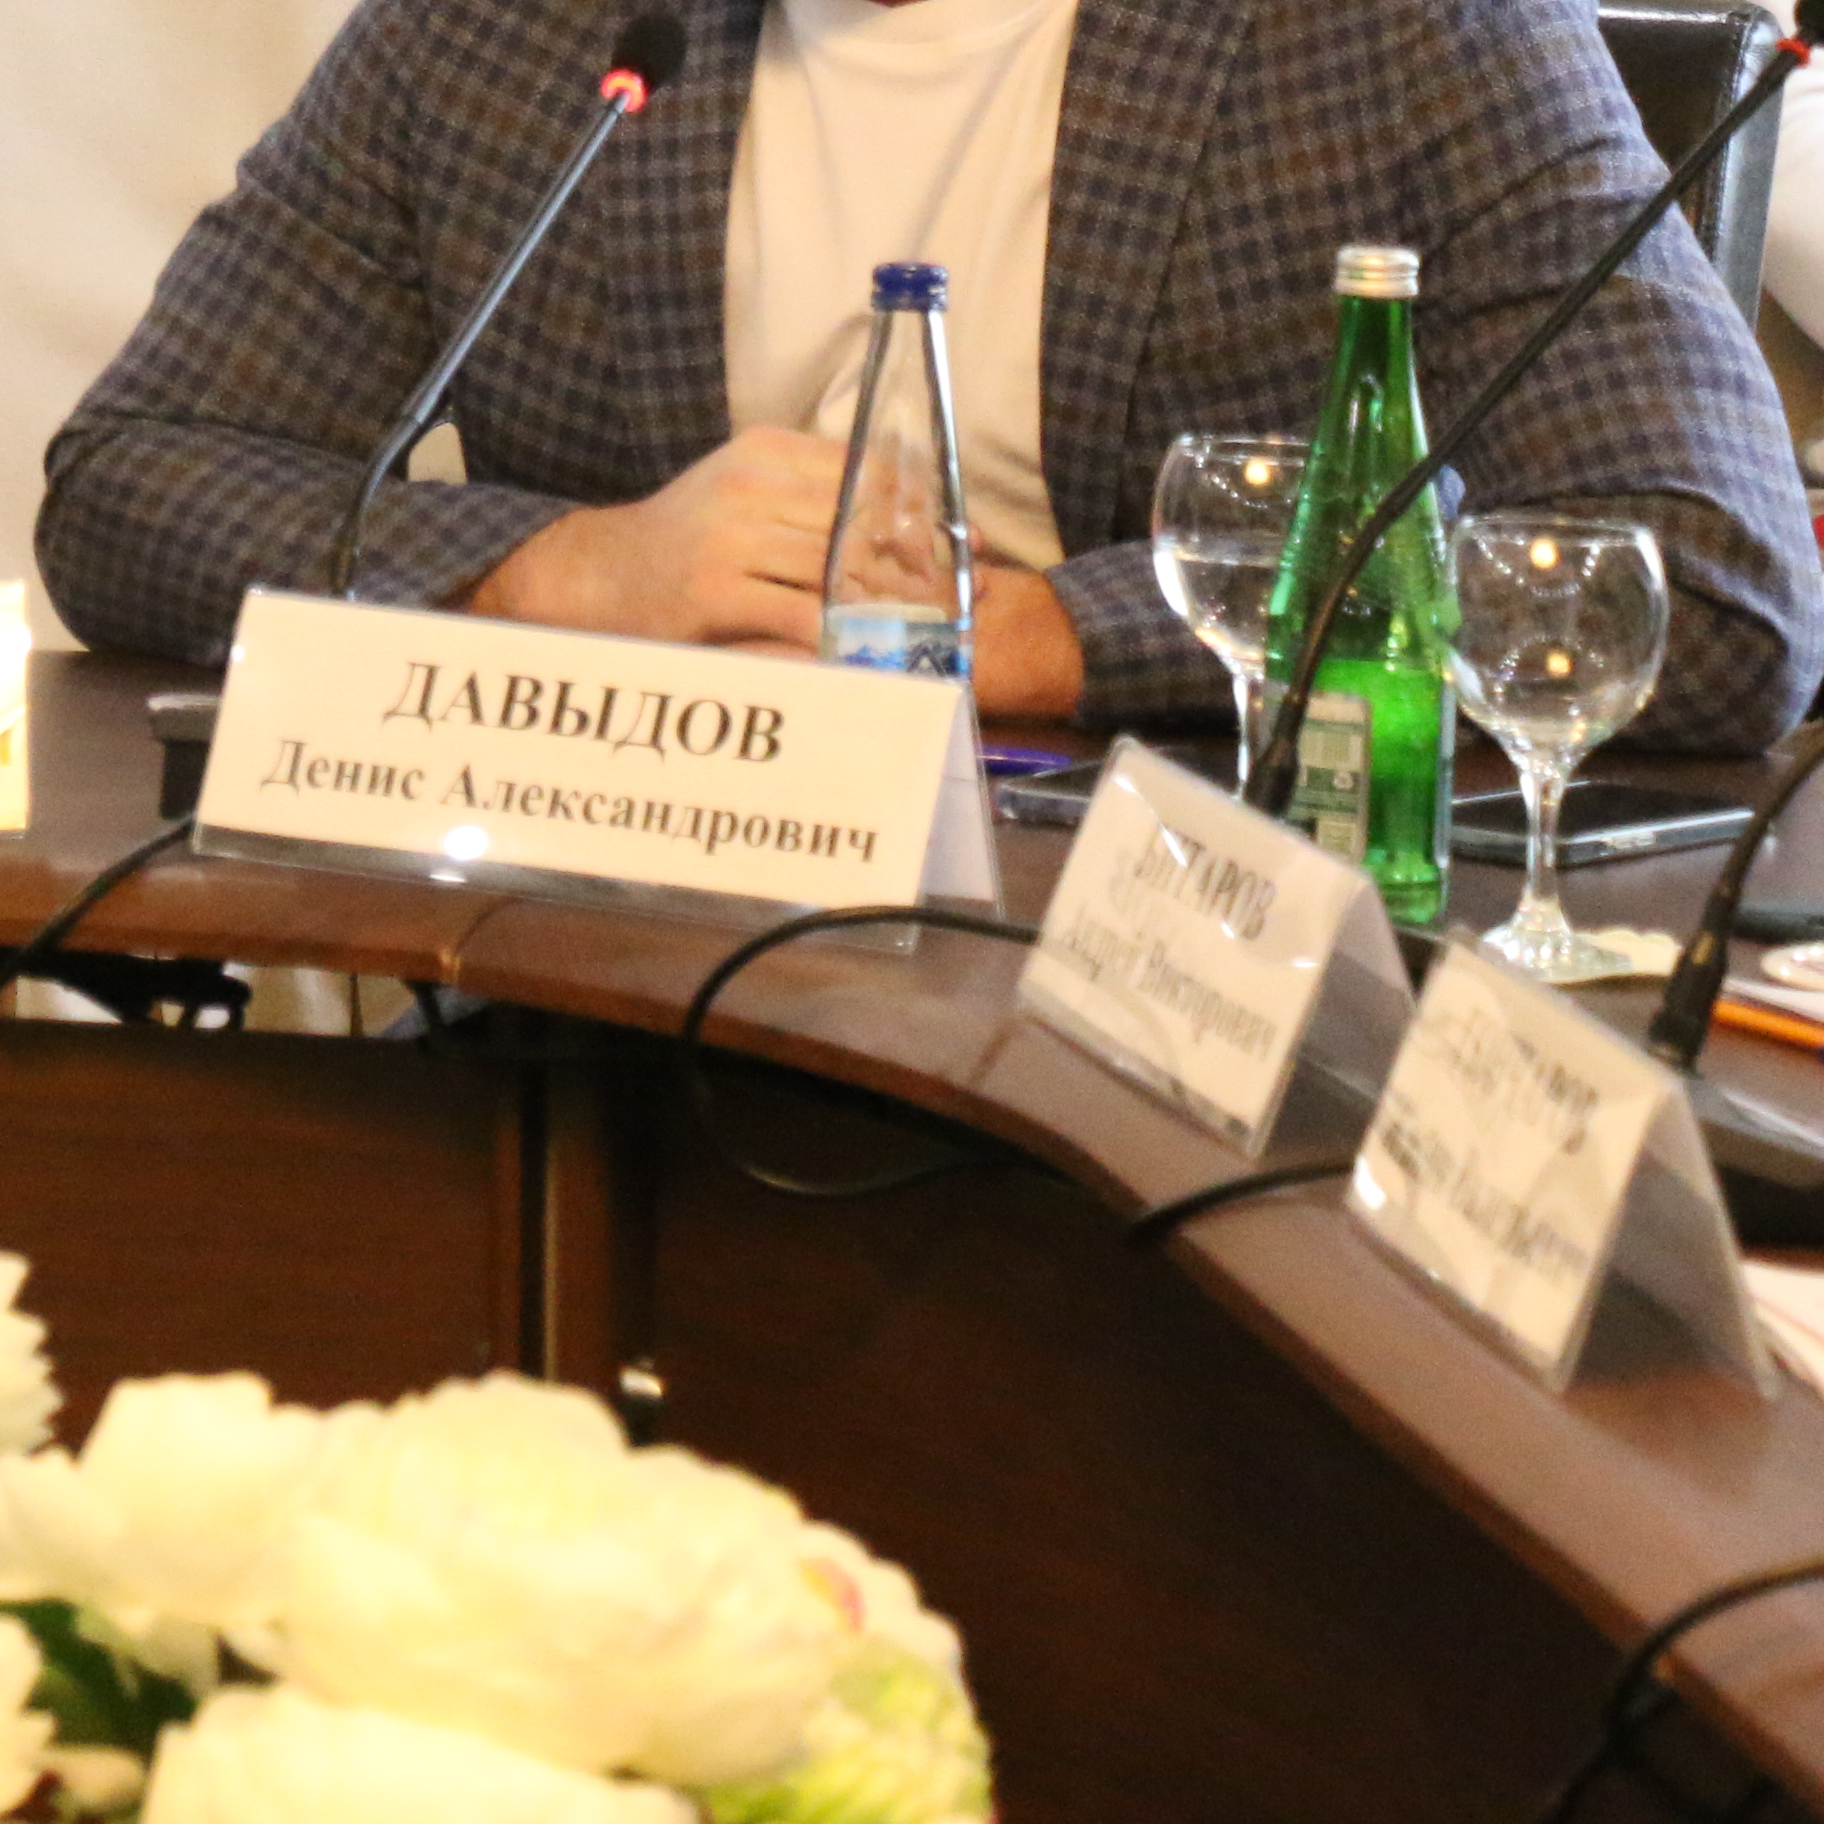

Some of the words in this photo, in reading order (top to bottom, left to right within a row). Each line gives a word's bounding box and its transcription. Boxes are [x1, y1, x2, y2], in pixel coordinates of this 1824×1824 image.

[380, 661, 788, 766] ДАВЫДОВ
[259, 737, 426, 800] Денис
[439, 762, 881, 866] Александрович
